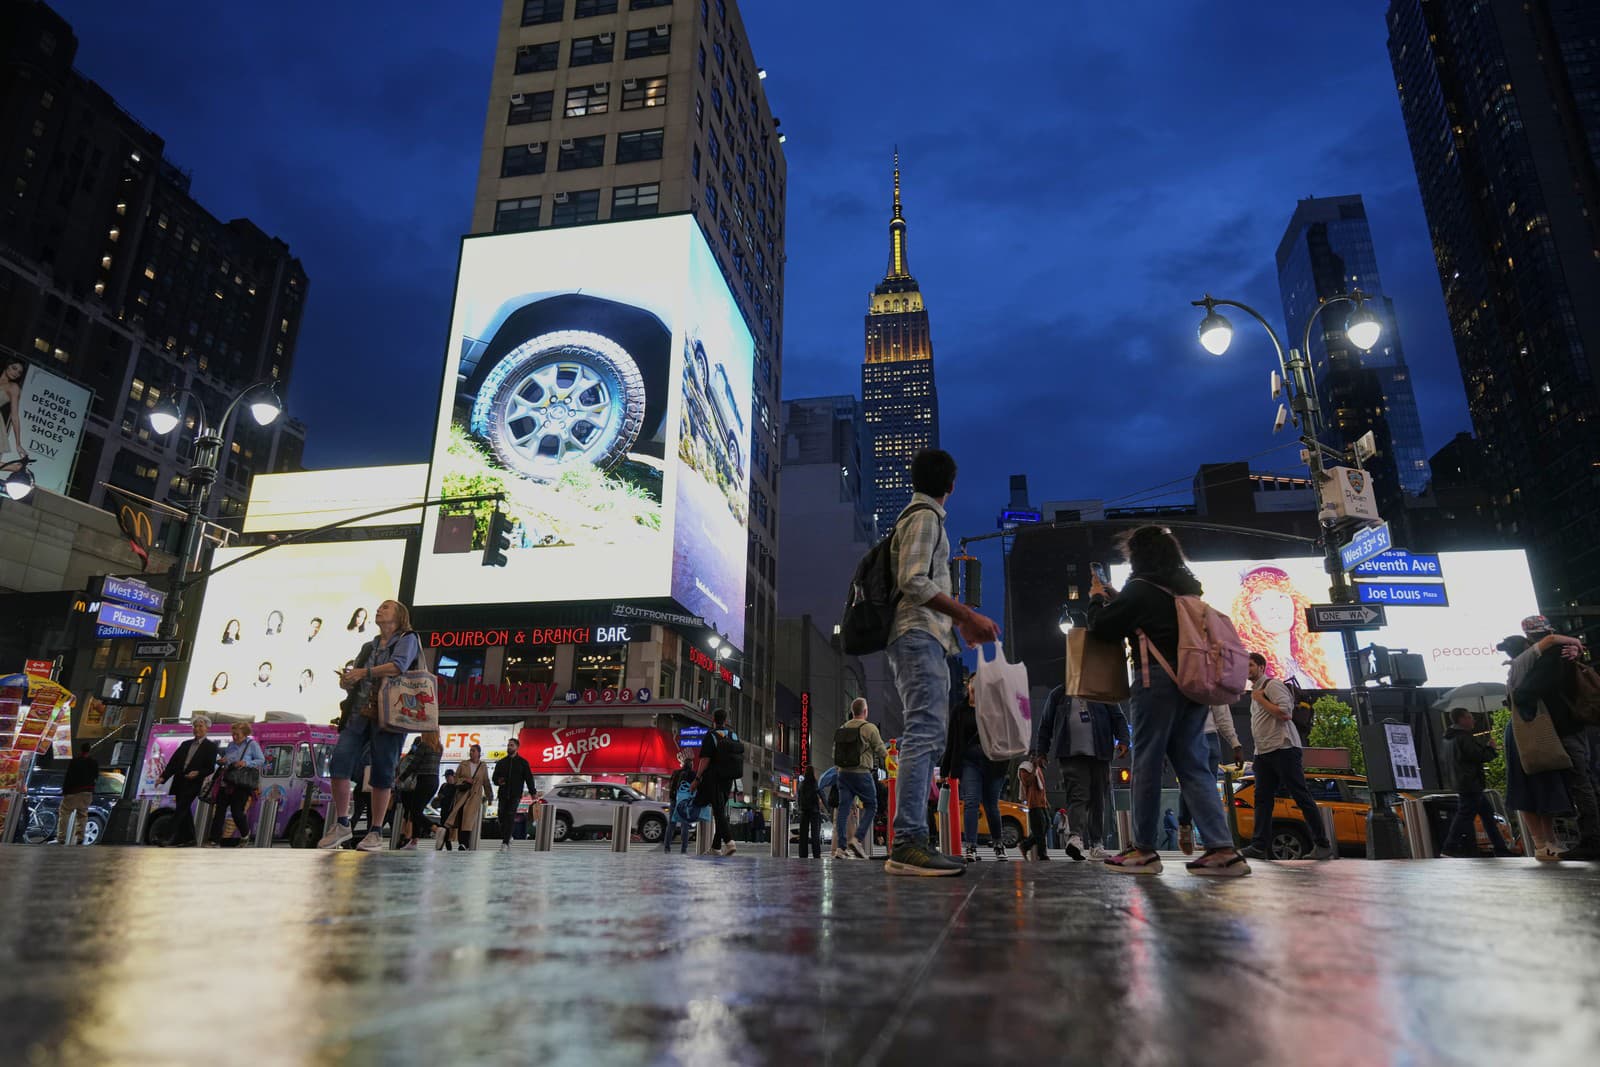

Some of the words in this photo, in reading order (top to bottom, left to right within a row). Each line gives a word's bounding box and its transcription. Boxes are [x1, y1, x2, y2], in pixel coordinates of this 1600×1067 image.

[31, 394, 77, 419] DESORBO
[43, 389, 72, 408] PAIGE
[23, 411, 55, 430] THING
[56, 426, 76, 439] FOR
[37, 407, 58, 421] HAS
[59, 417, 66, 425] A
[31, 425, 63, 443] SHOES
[29, 439, 59, 457] DSW
[1343, 546, 1362, 564] West
[1377, 531, 1387, 546] St
[1358, 559, 1409, 571] Seventh
[1412, 559, 1437, 571] Ave
[108, 581, 131, 598] West
[150, 594, 160, 606] St
[1367, 587, 1388, 599] Joe
[1389, 587, 1421, 600] Louis
[112, 611, 146, 628] Plaza33
[614, 604, 703, 626] #OUTFRONTPRIME
[1322, 612, 1342, 620] ONE
[1348, 611, 1369, 619] WAY
[430, 630, 510, 648] BOURBON
[514, 631, 527, 644] &
[532, 627, 591, 645] BRANCH
[596, 626, 631, 643] BAR
[1432, 641, 1499, 663] peacock
[437, 676, 558, 713] Subway
[604, 691, 611, 702] 2
[622, 690, 630, 701] 3
[446, 733, 481, 748] FTS
[542, 733, 611, 763] SBARRO
